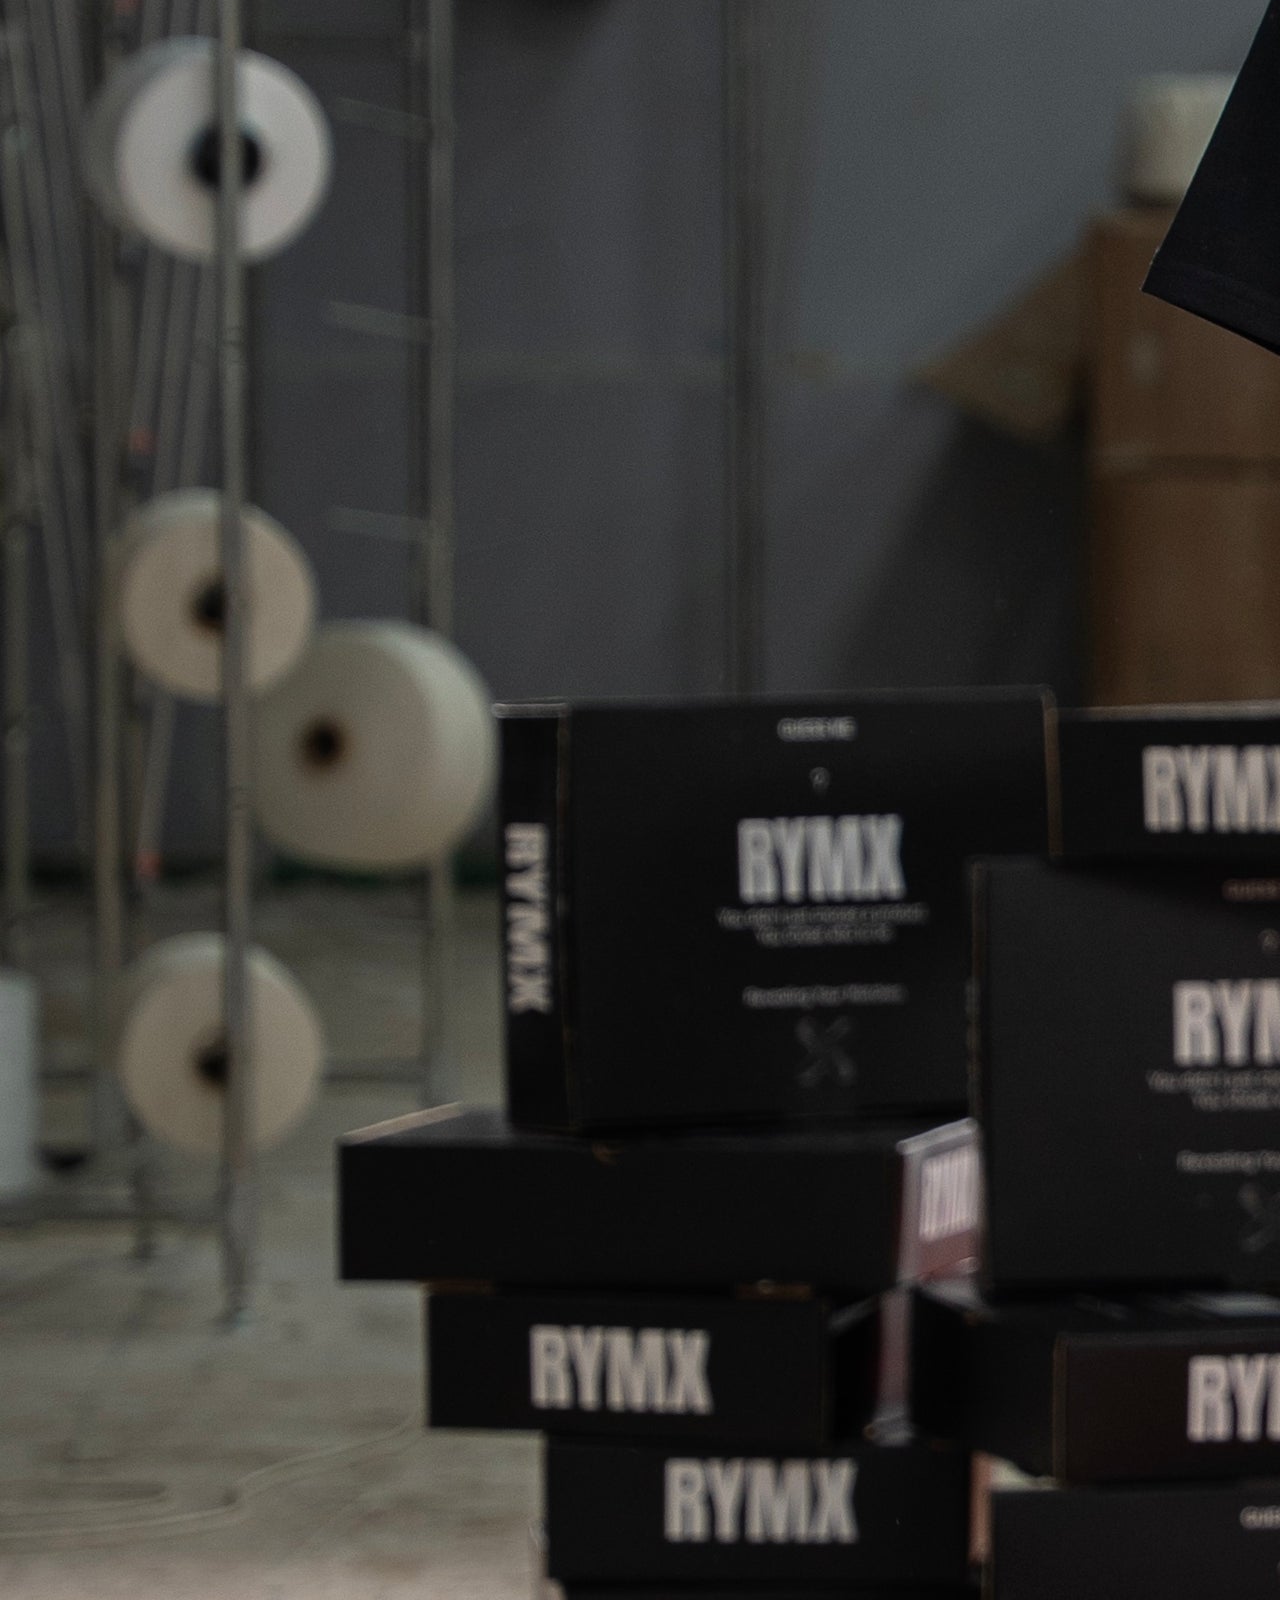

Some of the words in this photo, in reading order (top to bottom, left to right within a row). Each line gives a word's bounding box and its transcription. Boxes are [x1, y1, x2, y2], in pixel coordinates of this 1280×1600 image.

[738, 815, 904, 902] RYMX
[506, 823, 549, 1011] RYMX
[531, 1325, 711, 1413] RYMX
[664, 1458, 857, 1543] RYMX
